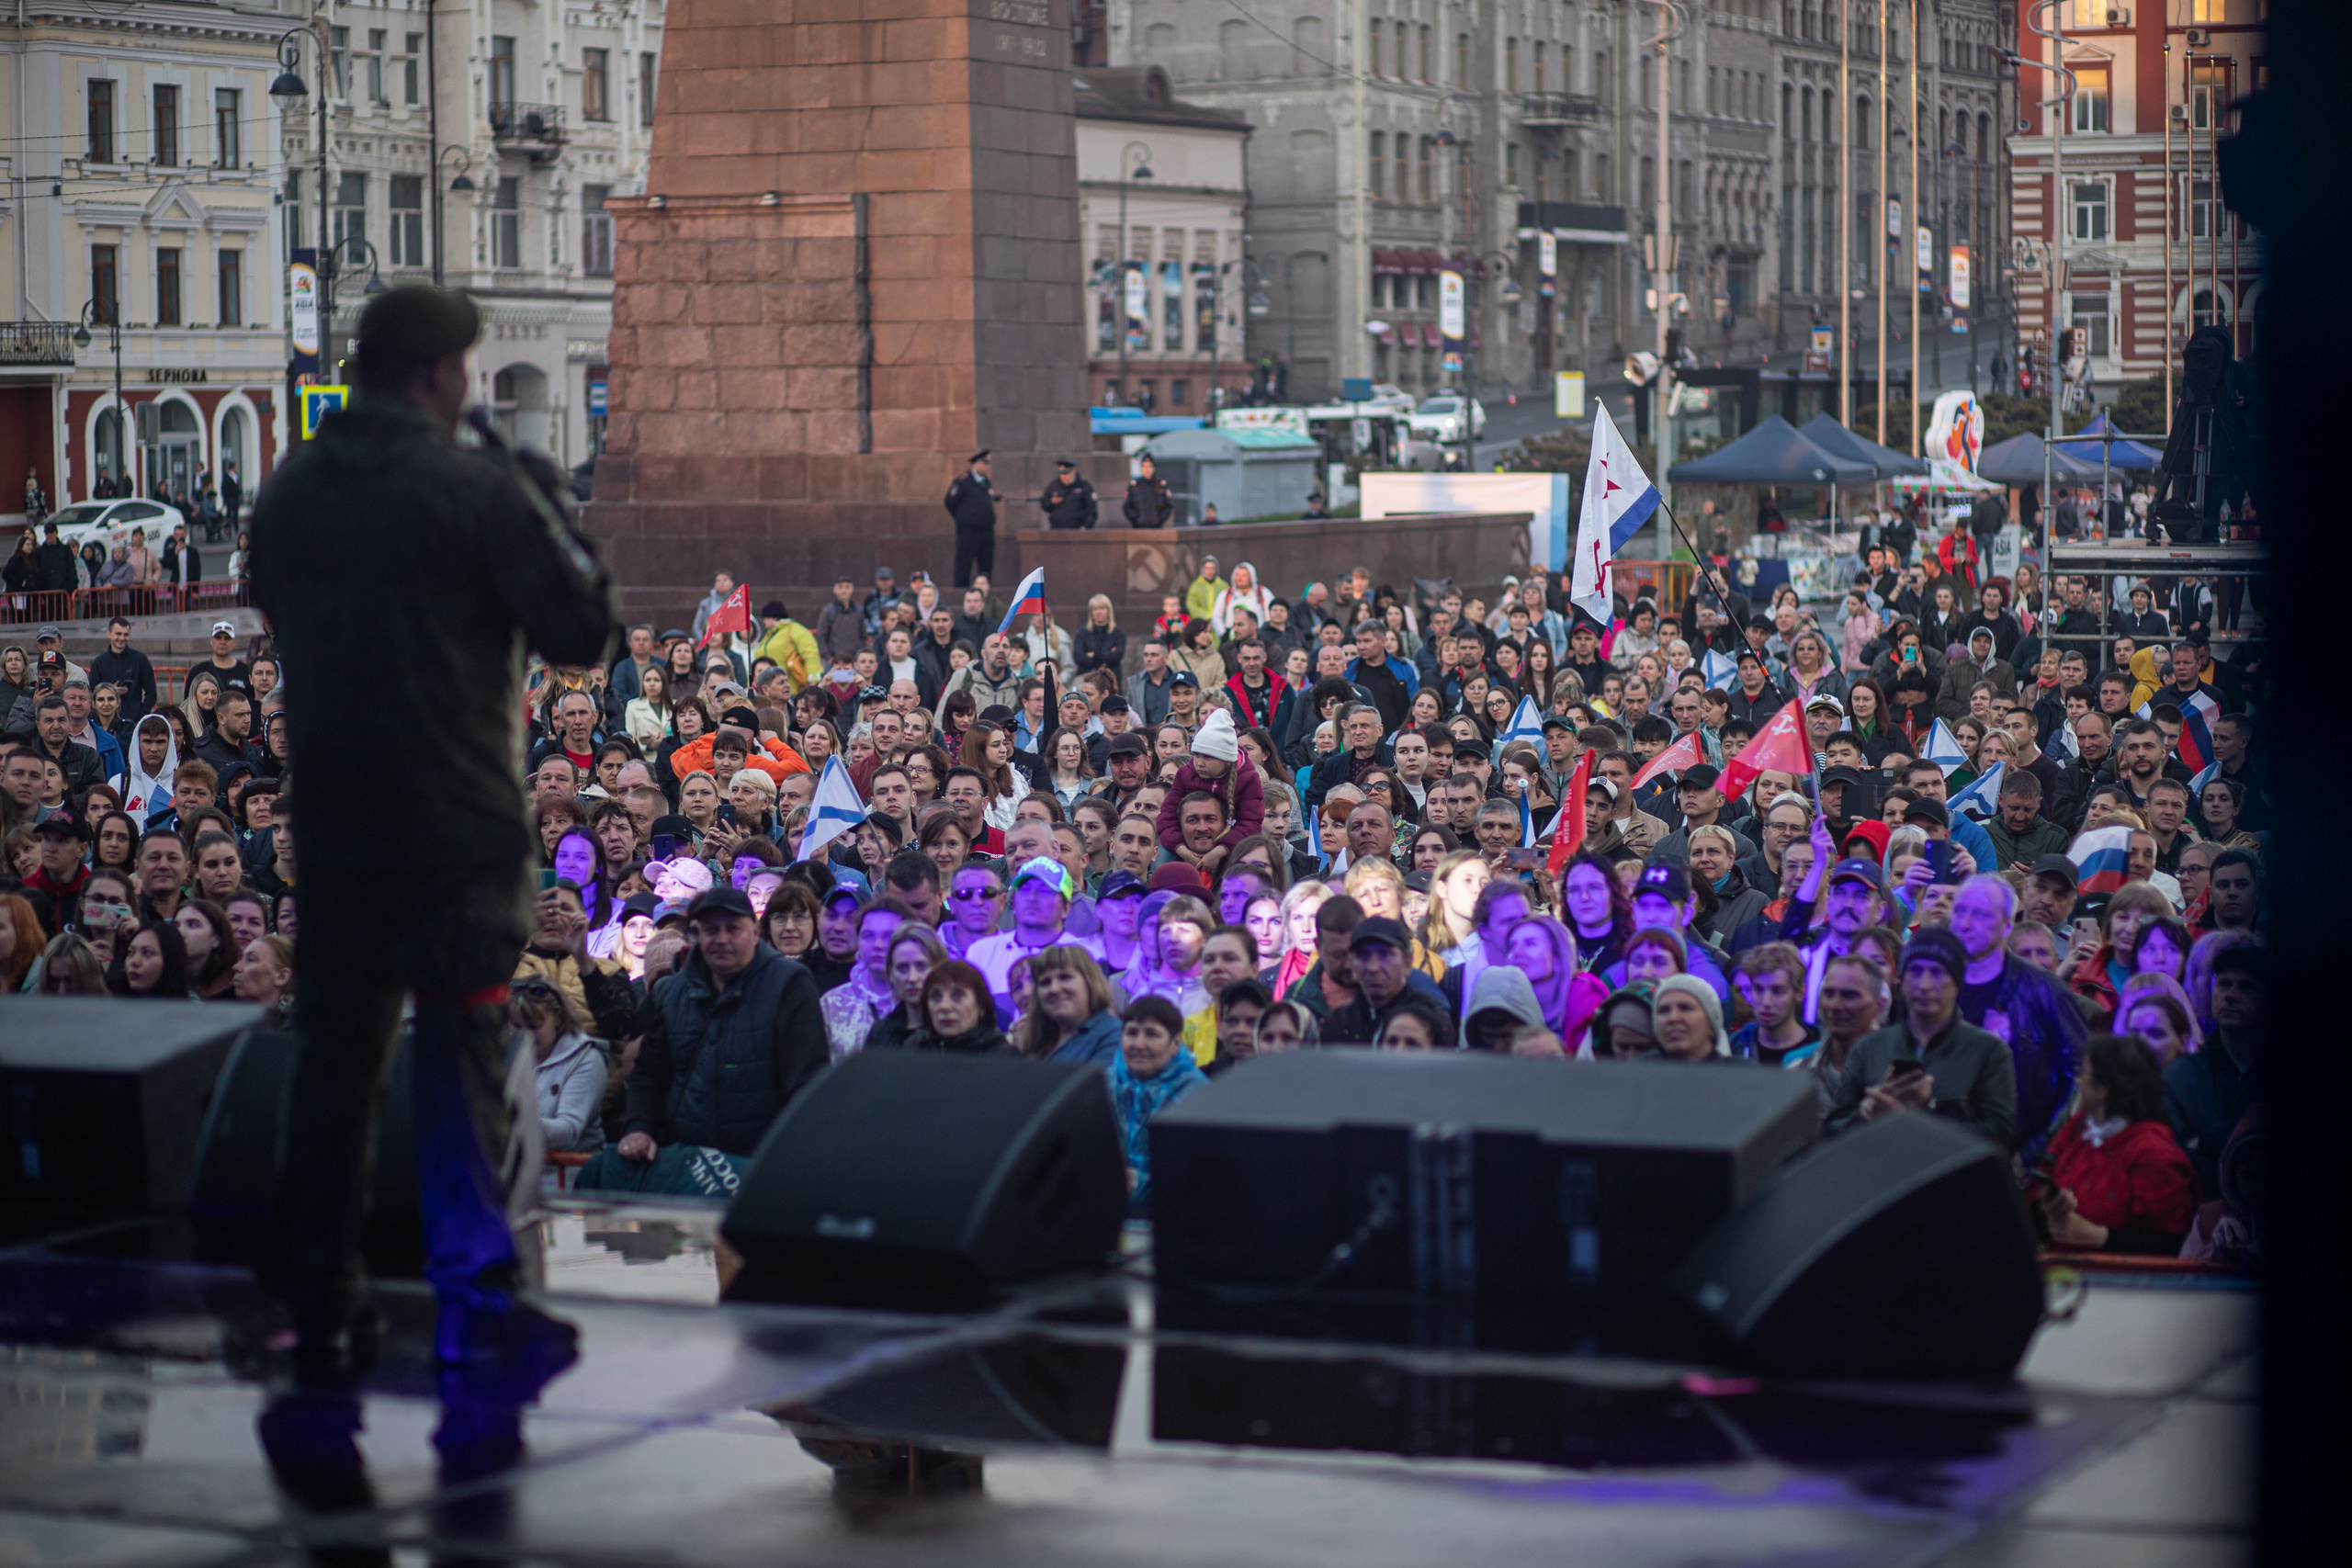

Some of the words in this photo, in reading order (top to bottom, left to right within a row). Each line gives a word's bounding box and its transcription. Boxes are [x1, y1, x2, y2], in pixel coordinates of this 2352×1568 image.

[148, 368, 208, 382] SEPHORA
[1995, 538, 2011, 556] ASIA
[685, 1155, 720, 1195] МЧС
